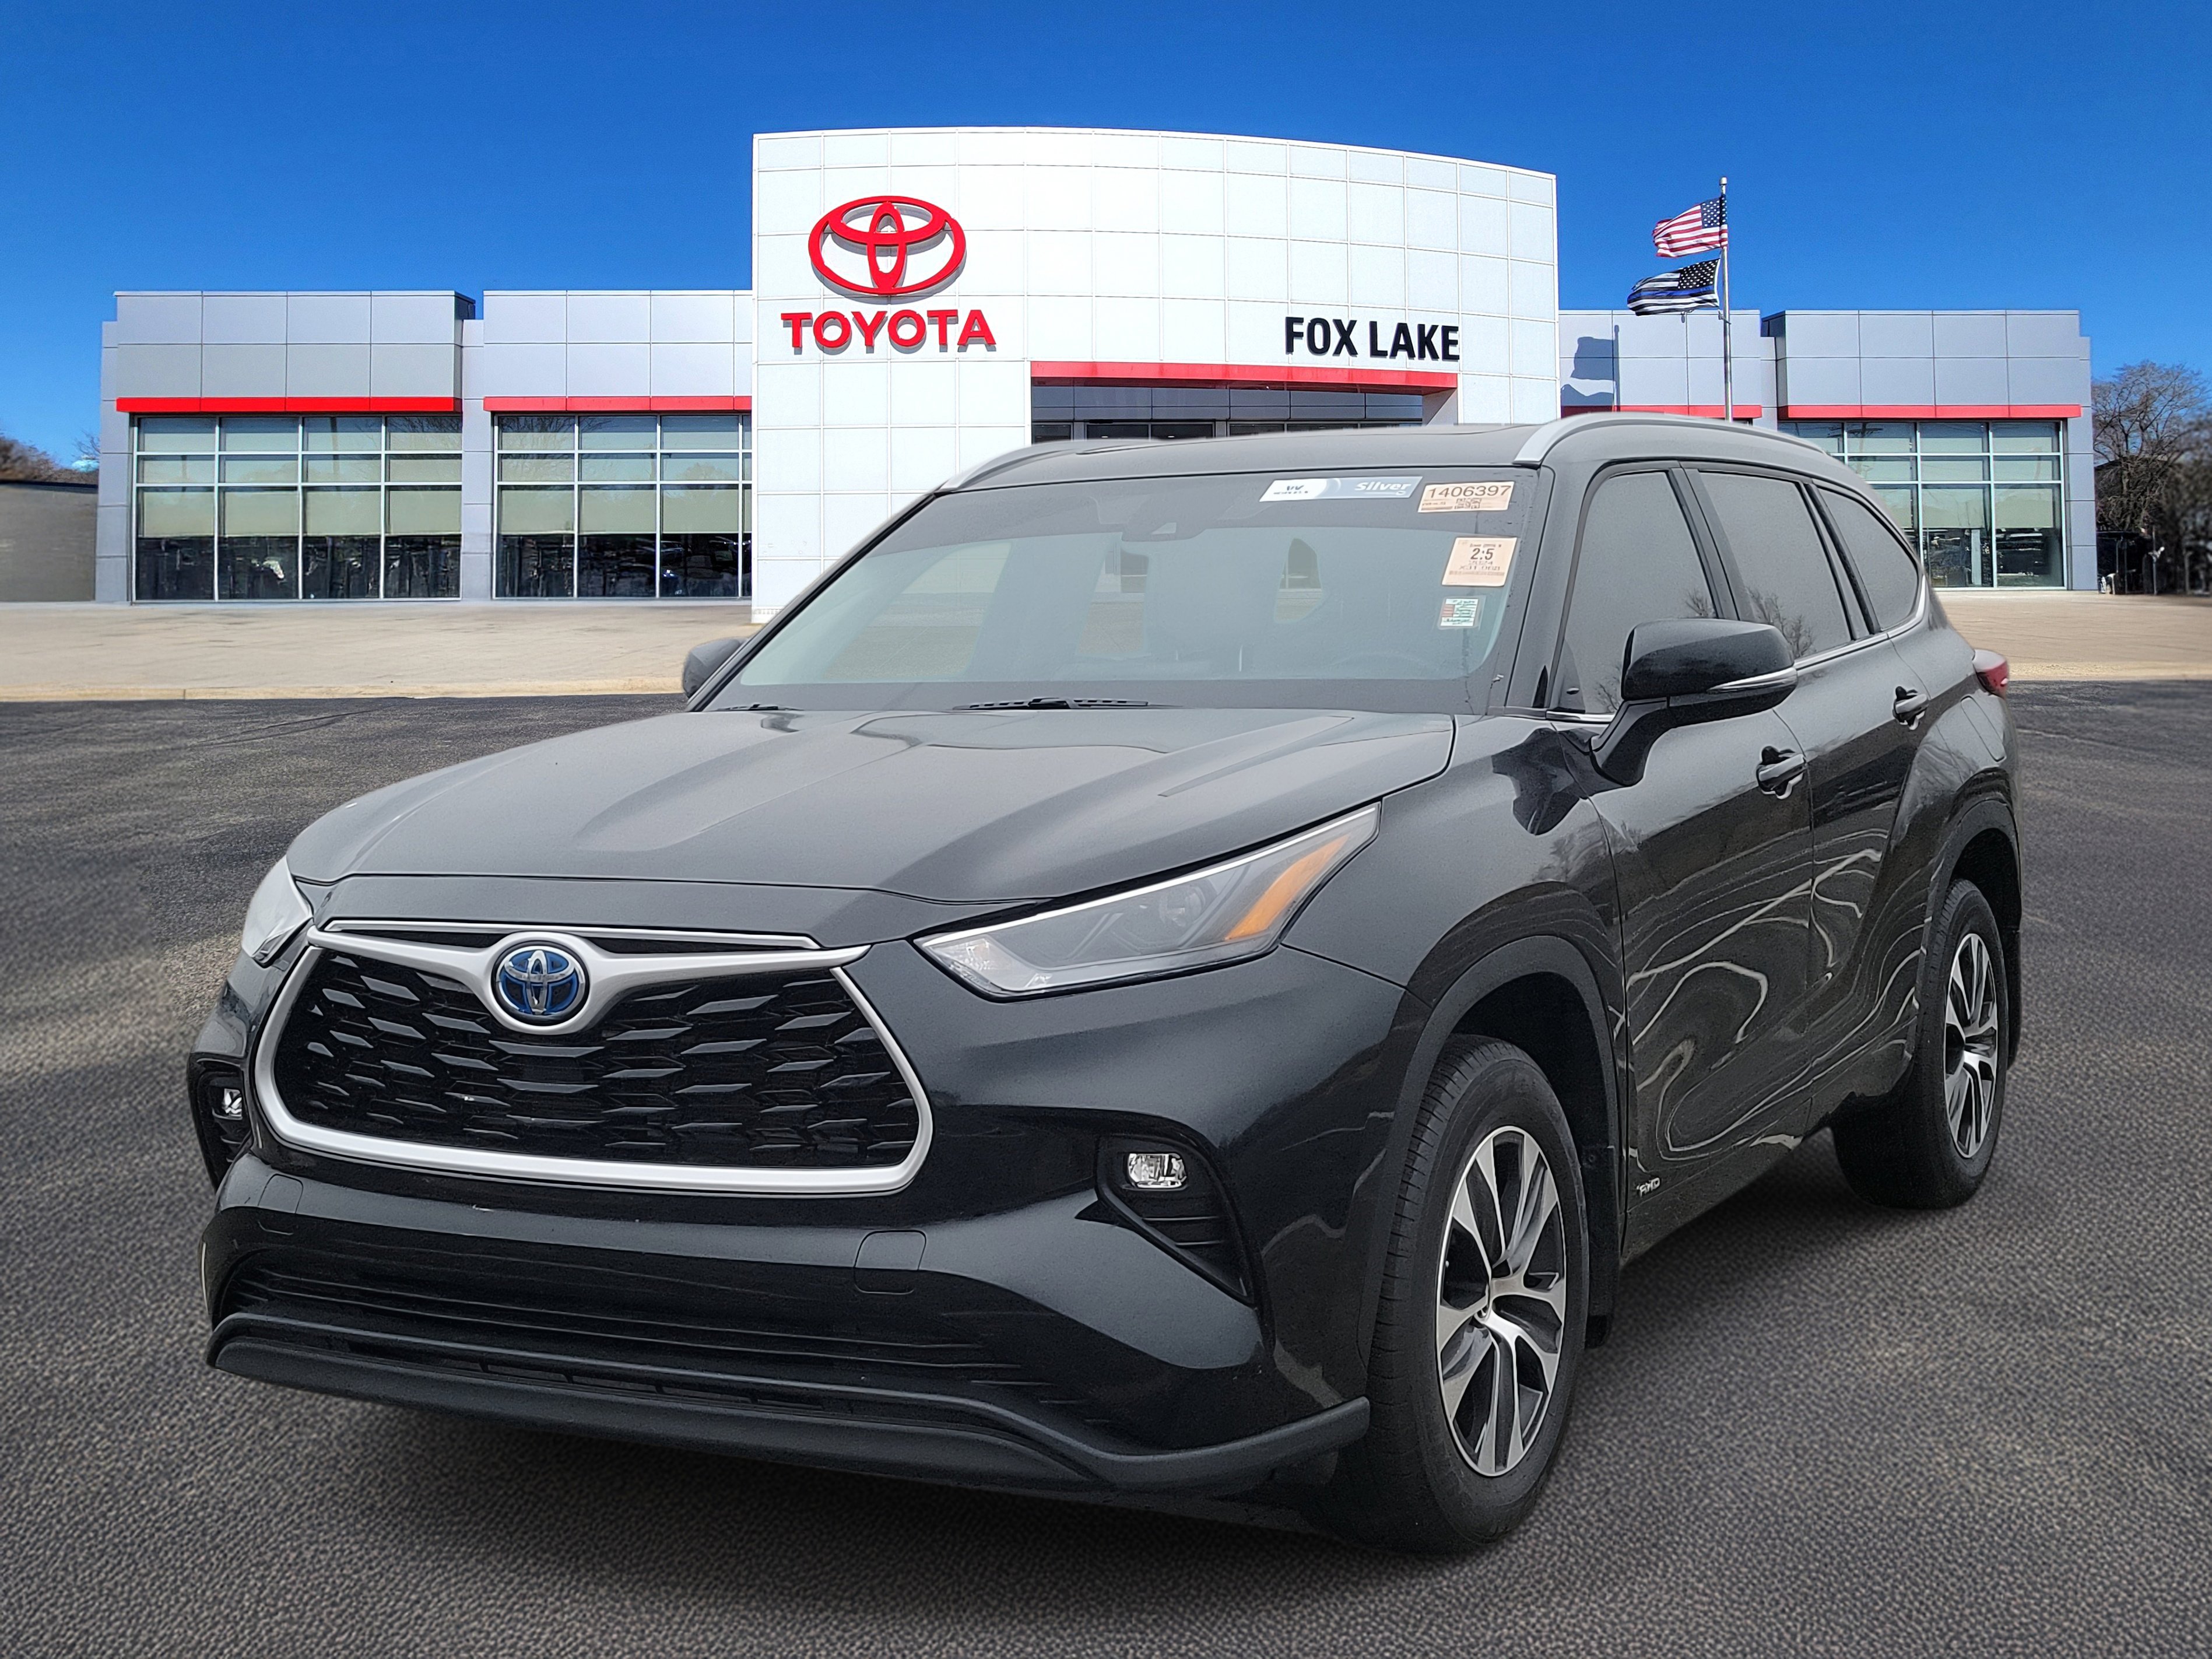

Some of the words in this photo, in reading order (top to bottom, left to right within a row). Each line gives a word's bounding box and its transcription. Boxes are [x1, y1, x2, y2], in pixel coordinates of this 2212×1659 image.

[781, 309, 996, 349] TOYOTA
[1285, 317, 1358, 357] FOX
[1369, 321, 1460, 361] LAKE
[1428, 485, 1512, 499] 1406397
